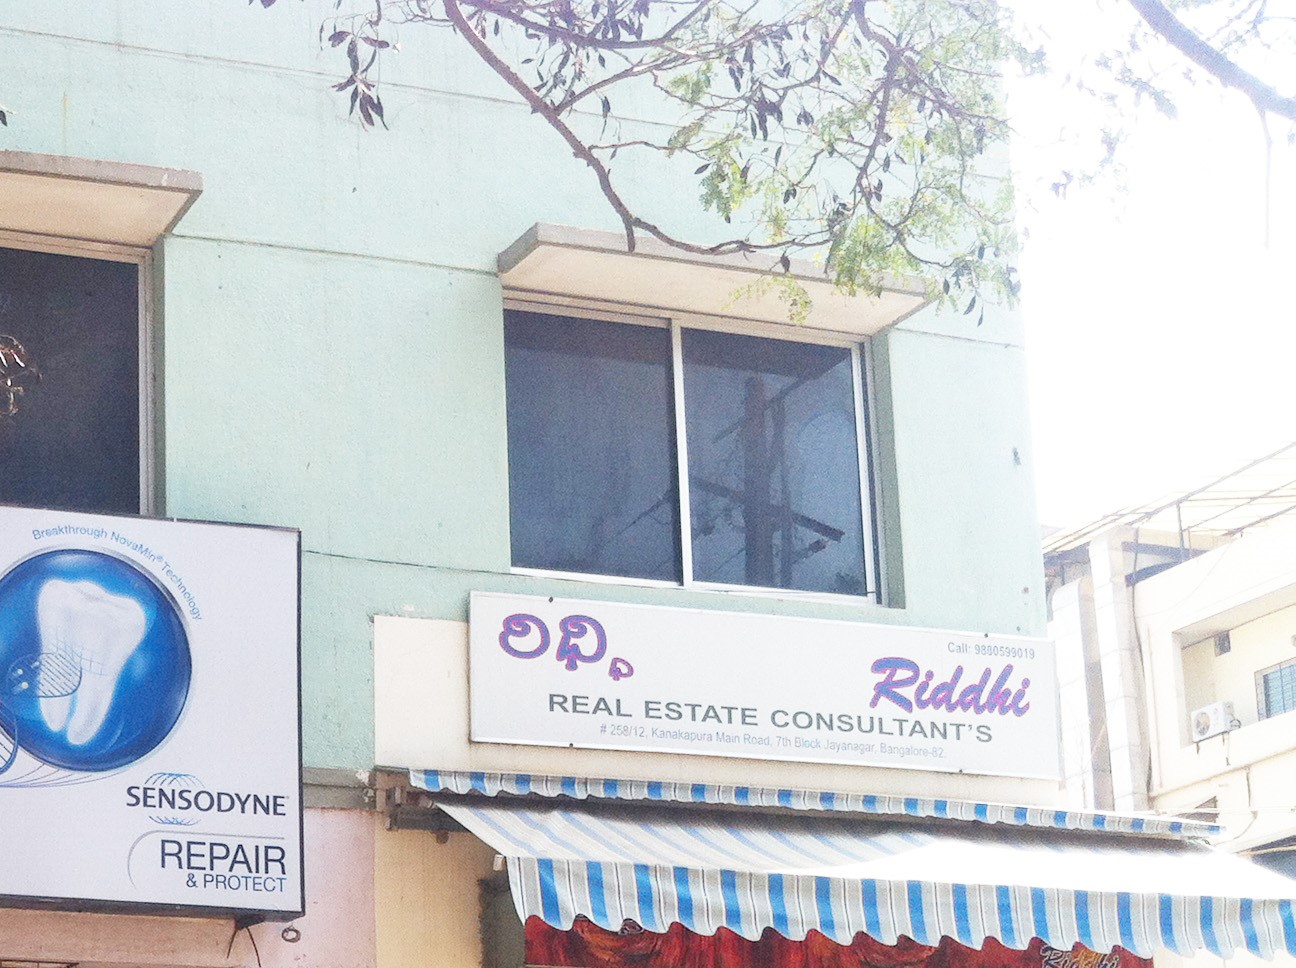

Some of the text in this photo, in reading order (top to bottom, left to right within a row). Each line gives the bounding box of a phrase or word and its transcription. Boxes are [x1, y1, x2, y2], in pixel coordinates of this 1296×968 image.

[32, 525, 108, 540] Breakthrough
[161, 561, 202, 620] Technology
[947, 641, 971, 654] Call:
[869, 655, 1031, 718] Riddhi
[548, 693, 993, 744] REAL ESTATE CONSULTANT'S
[651, 727, 713, 744] Kanakapura
[716, 731, 740, 744] Main
[776, 735, 792, 747] 7th
[794, 736, 821, 749] Block
[161, 839, 286, 875] REPAIR
[186, 872, 287, 892] & PROTECT
